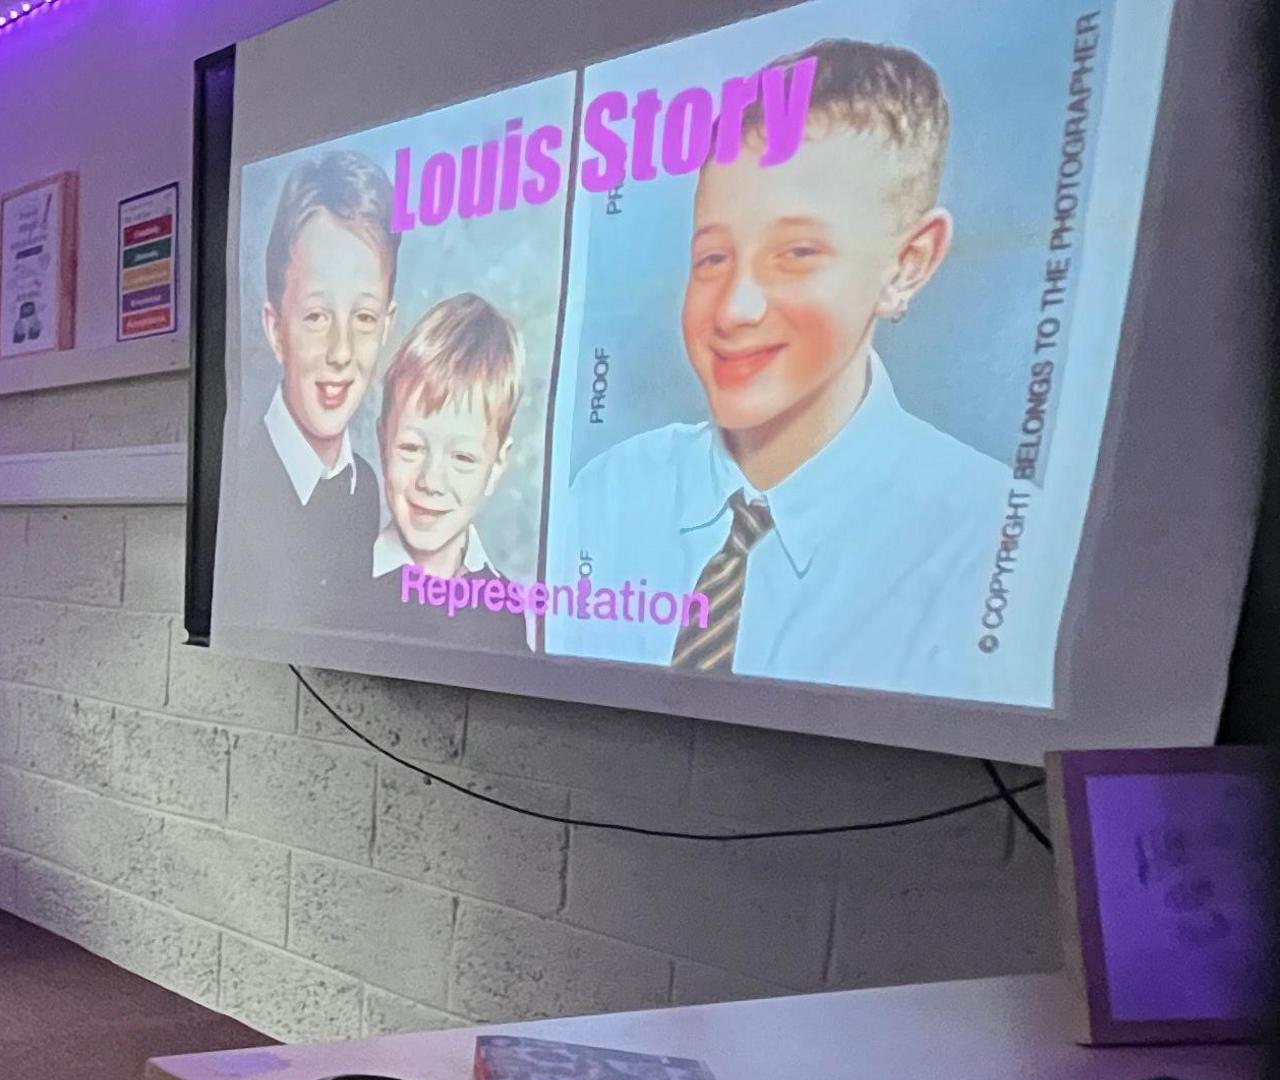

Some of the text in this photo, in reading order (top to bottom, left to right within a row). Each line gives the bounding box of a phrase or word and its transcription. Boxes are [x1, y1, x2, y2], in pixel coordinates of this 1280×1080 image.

[391, 56, 818, 233] Louis Story
[1050, 10, 1101, 251] PHOTOGRAPHER
[1041, 257, 1072, 312] THE
[589, 347, 610, 424] PROOF
[1035, 317, 1061, 355] TO
[1013, 359, 1054, 481] BELONGS
[401, 564, 709, 630] Representation
[982, 489, 1032, 630] COPYRIGHT
